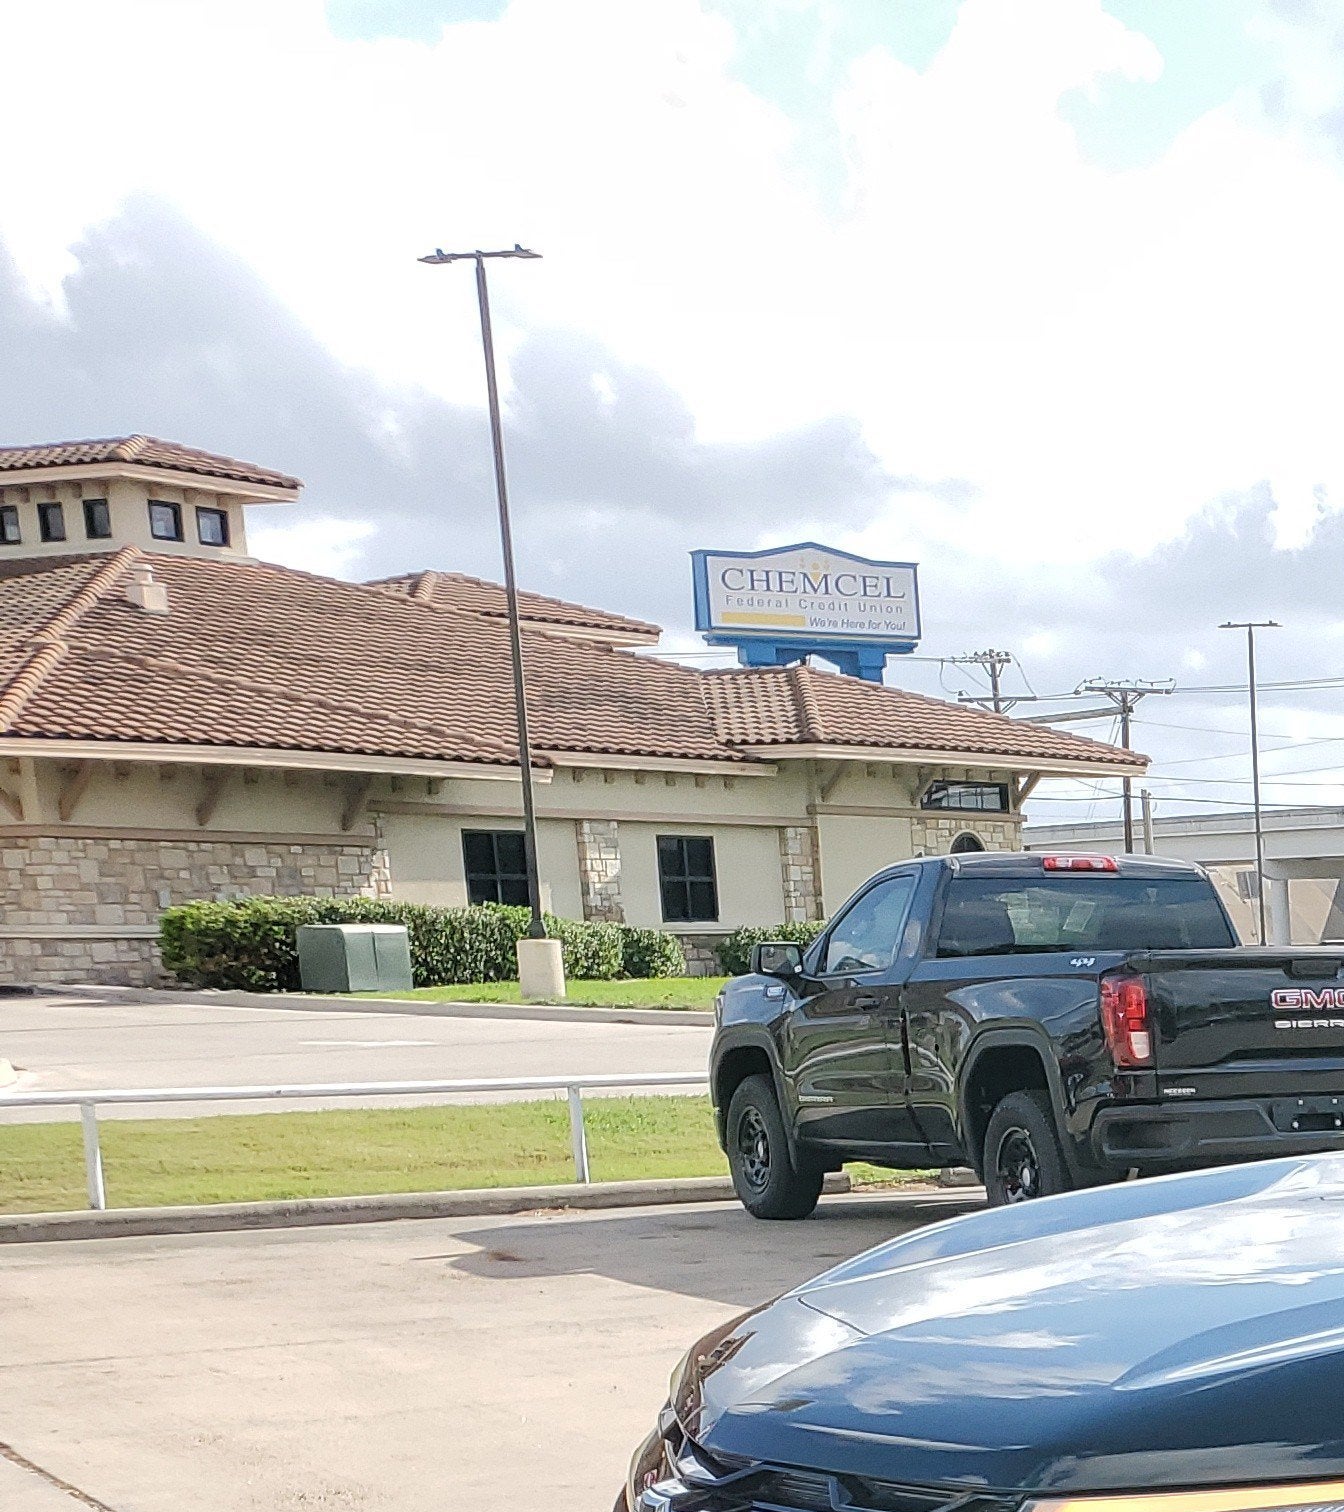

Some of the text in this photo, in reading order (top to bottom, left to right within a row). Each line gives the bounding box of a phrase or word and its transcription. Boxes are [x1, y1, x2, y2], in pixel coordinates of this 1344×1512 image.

[721, 567, 906, 599] CHEMCEL
[725, 594, 904, 615] Federal Credit Union
[809, 615, 907, 632] We're Here for You!
